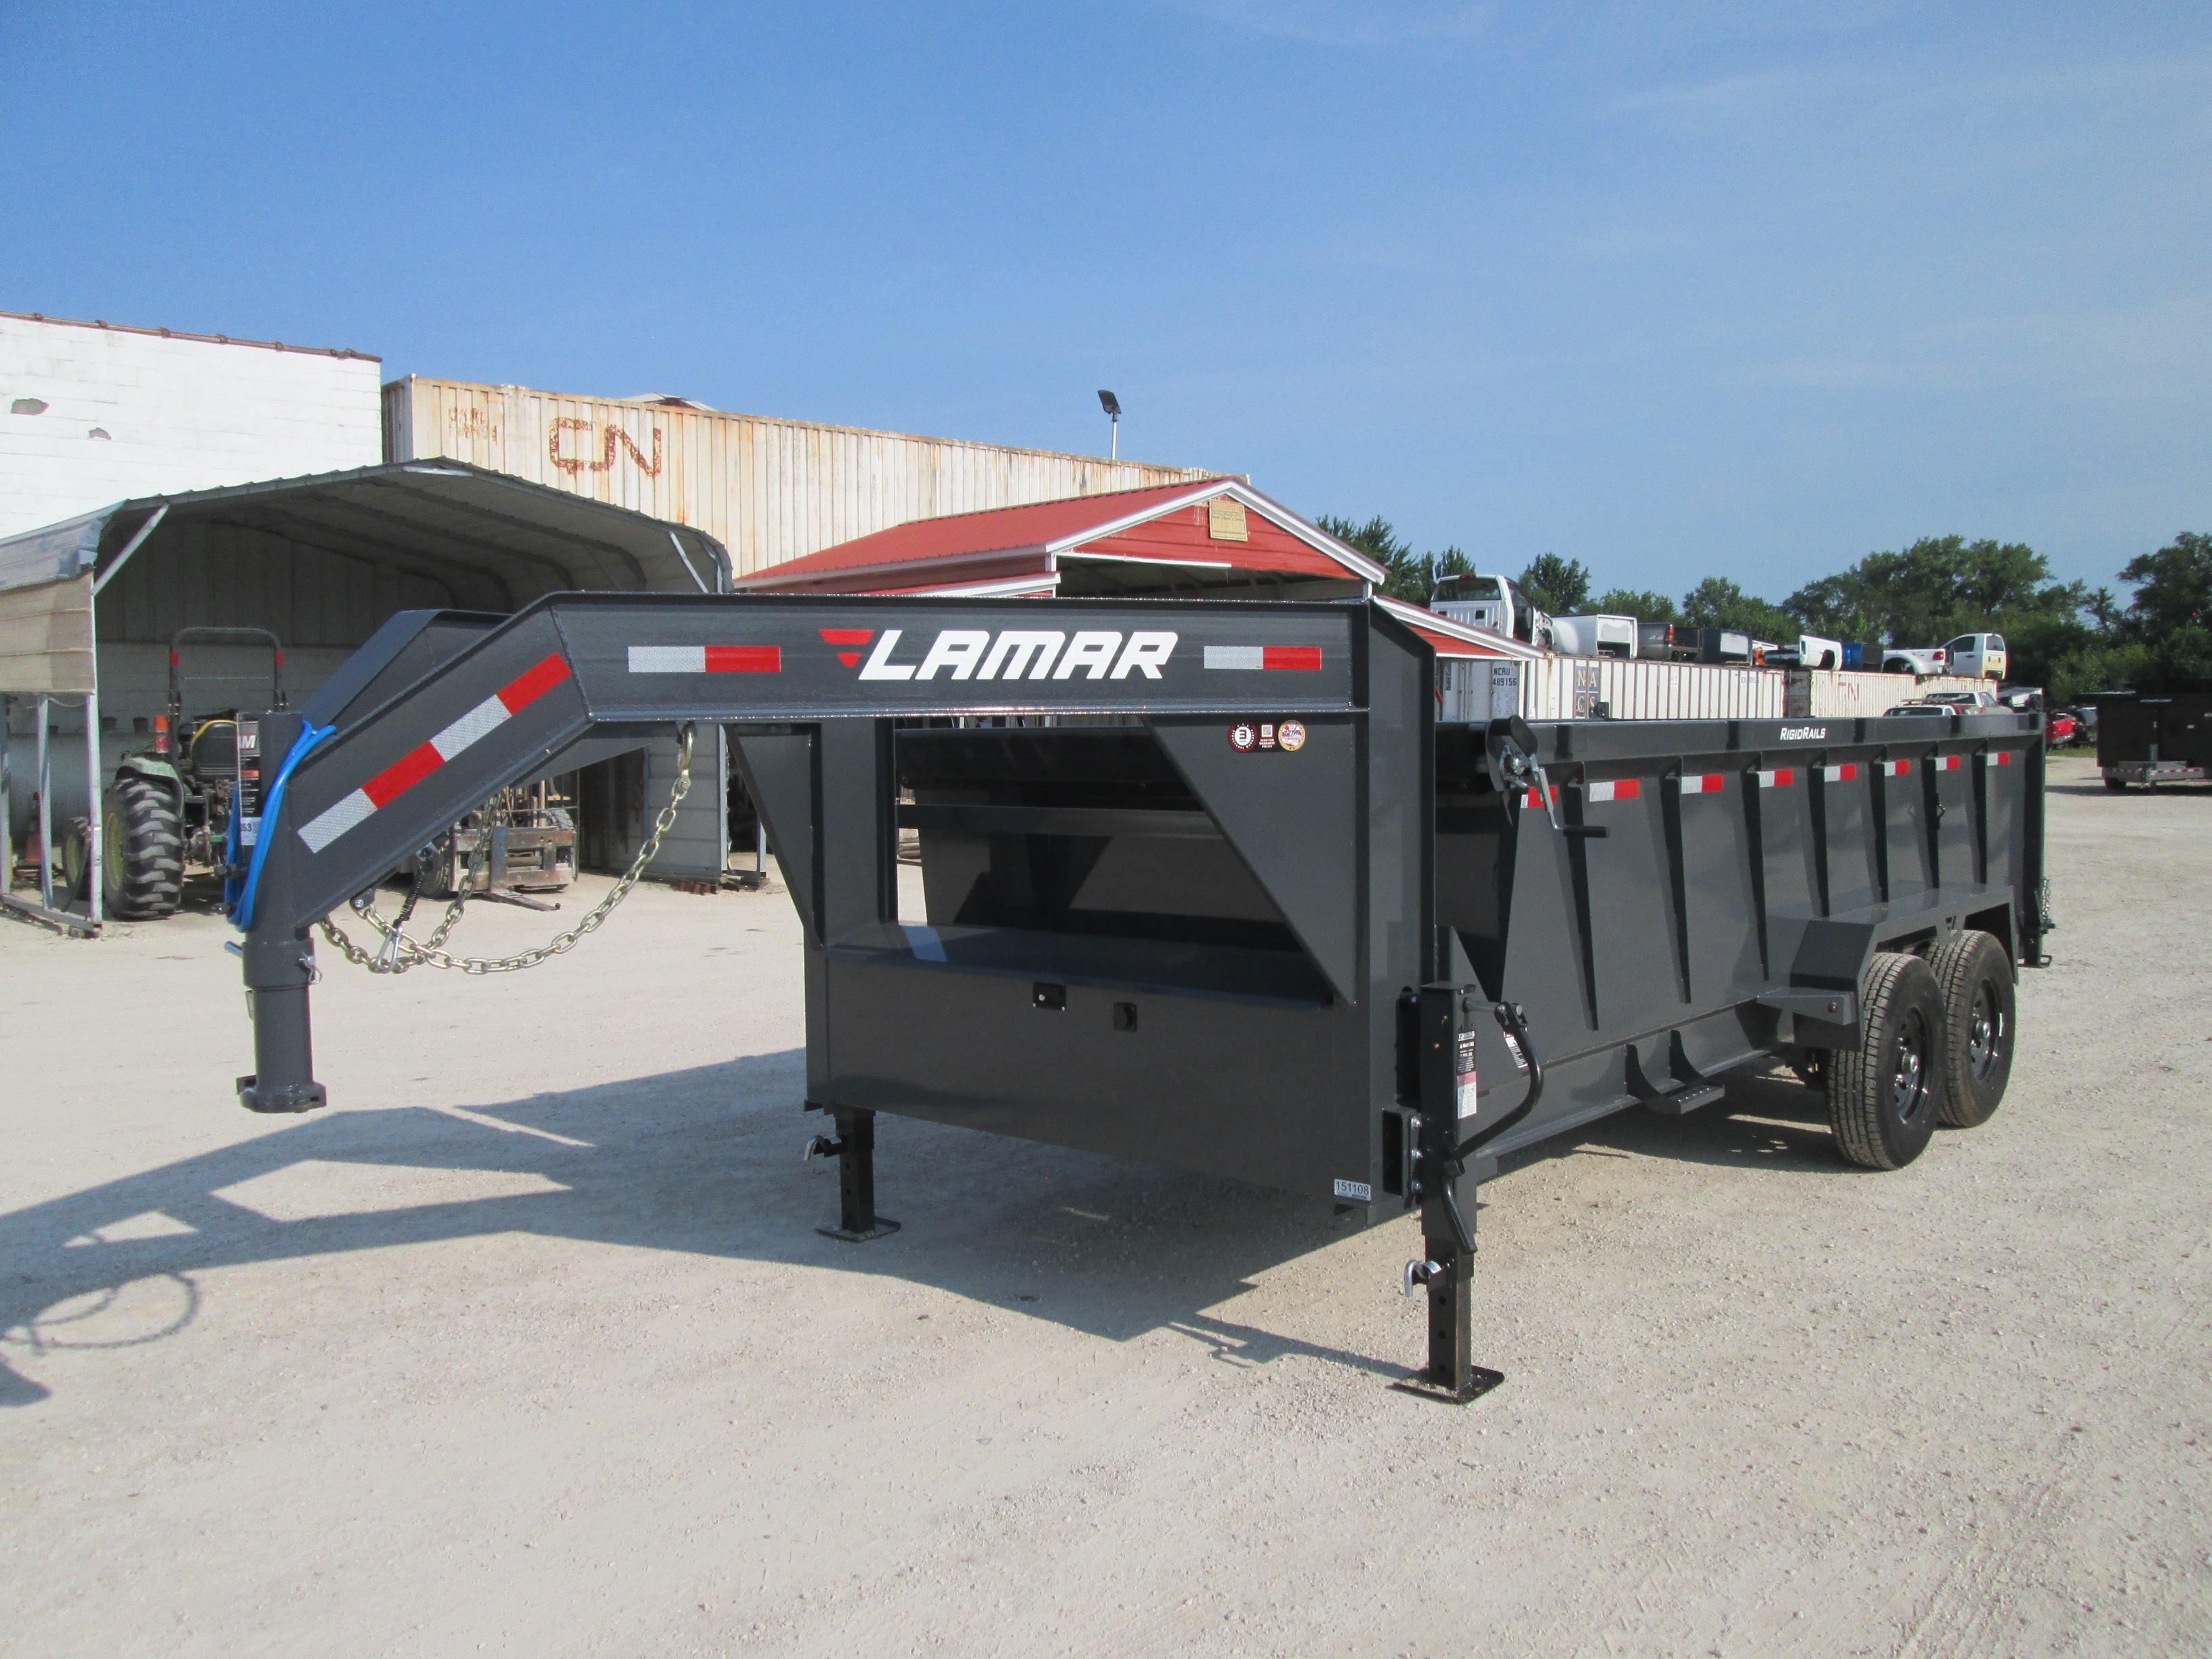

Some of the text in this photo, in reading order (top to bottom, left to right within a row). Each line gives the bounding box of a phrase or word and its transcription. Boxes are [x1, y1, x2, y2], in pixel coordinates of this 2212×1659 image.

[549, 417, 661, 477] CN
[858, 630, 1178, 680] LAMAR
[1493, 668, 1511, 676] NCRU
[1239, 729, 1247, 739] 3
[1336, 1181, 1369, 1195] 151108
